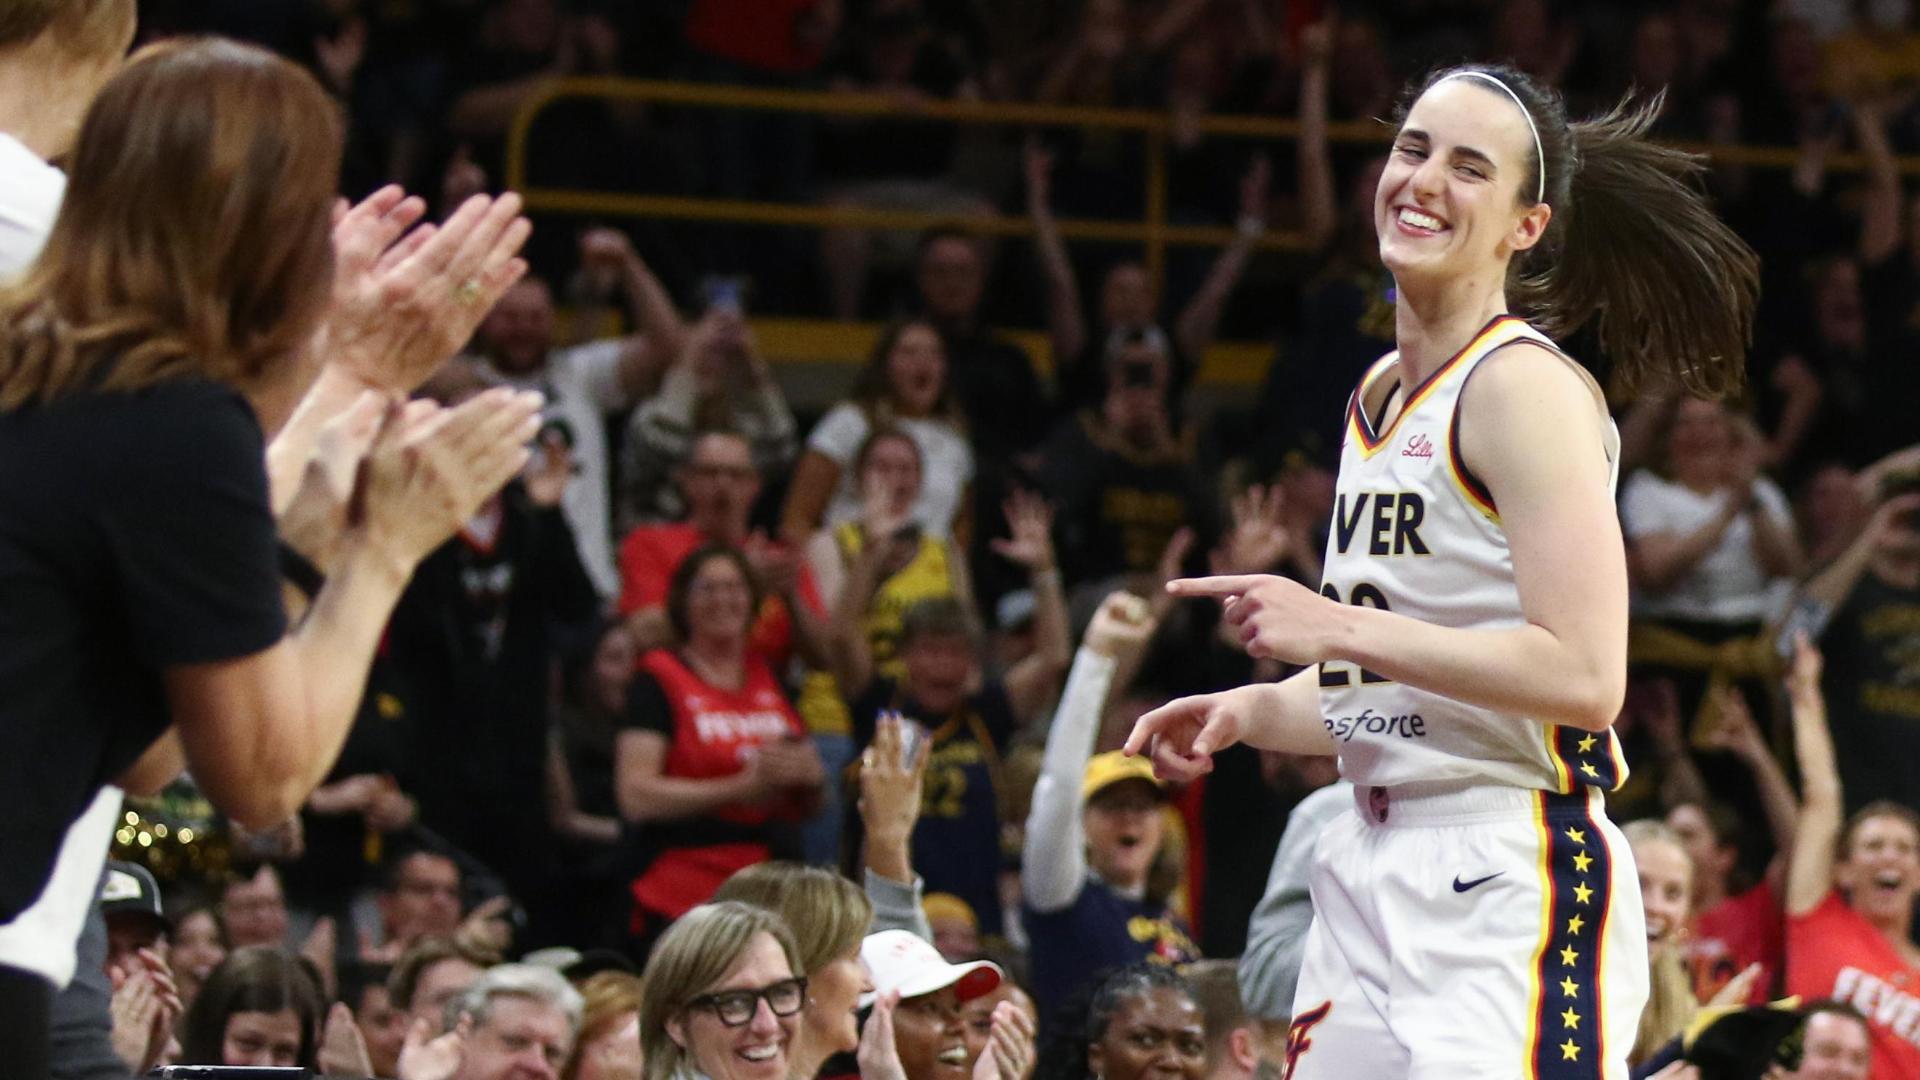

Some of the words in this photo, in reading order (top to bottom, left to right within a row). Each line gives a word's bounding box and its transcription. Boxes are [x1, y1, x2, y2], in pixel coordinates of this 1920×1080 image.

[1402, 433, 1433, 465] Lilly
[1336, 491, 1432, 556] VER
[1324, 709, 1427, 742] esforce
[1832, 965, 1920, 1048] FEVE
